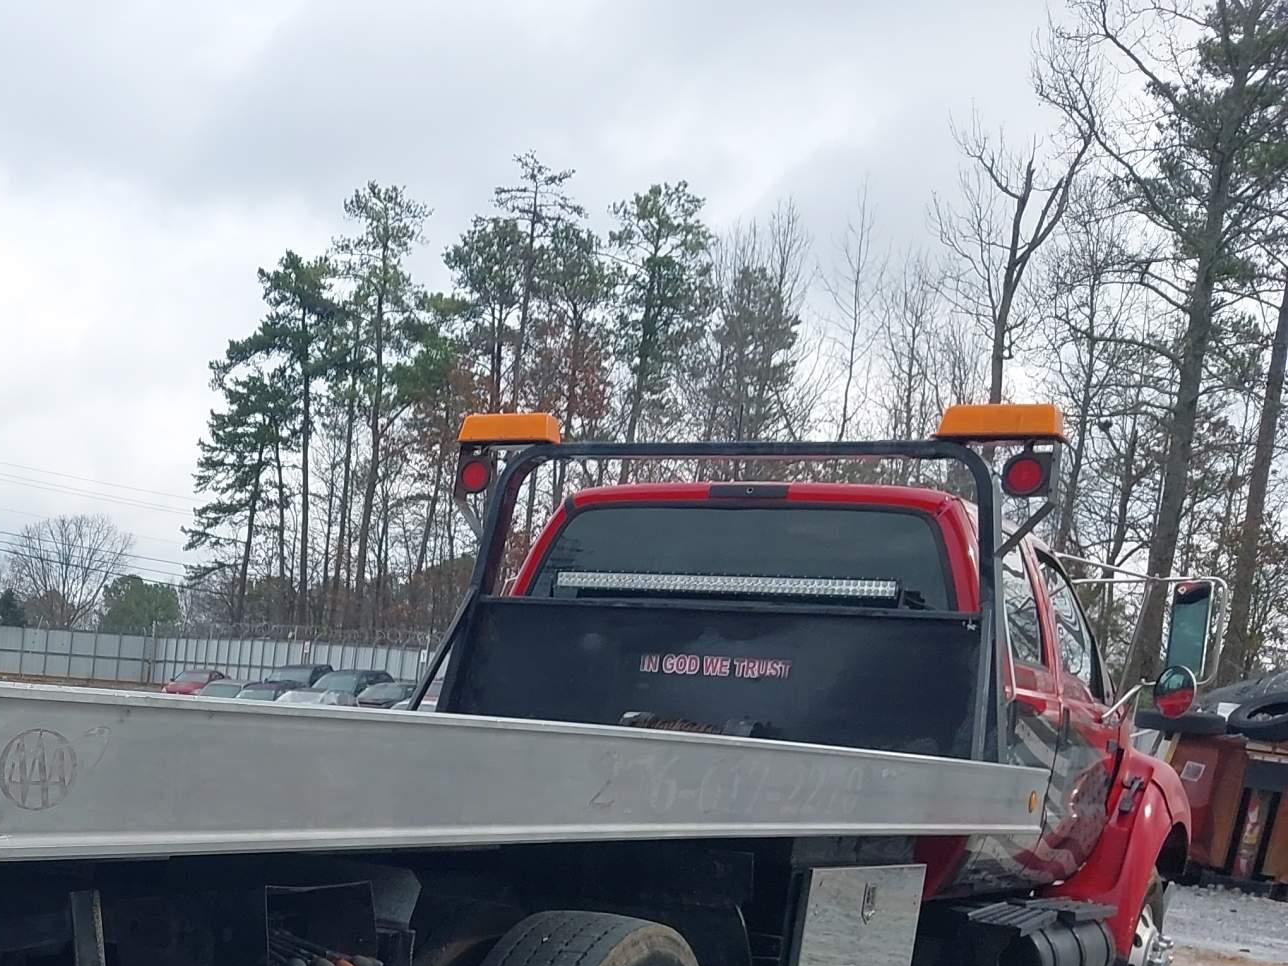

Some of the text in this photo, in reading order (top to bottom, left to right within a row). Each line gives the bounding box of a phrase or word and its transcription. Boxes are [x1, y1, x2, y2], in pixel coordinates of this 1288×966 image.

[640, 654, 792, 679] IN GOD WE TRUST
